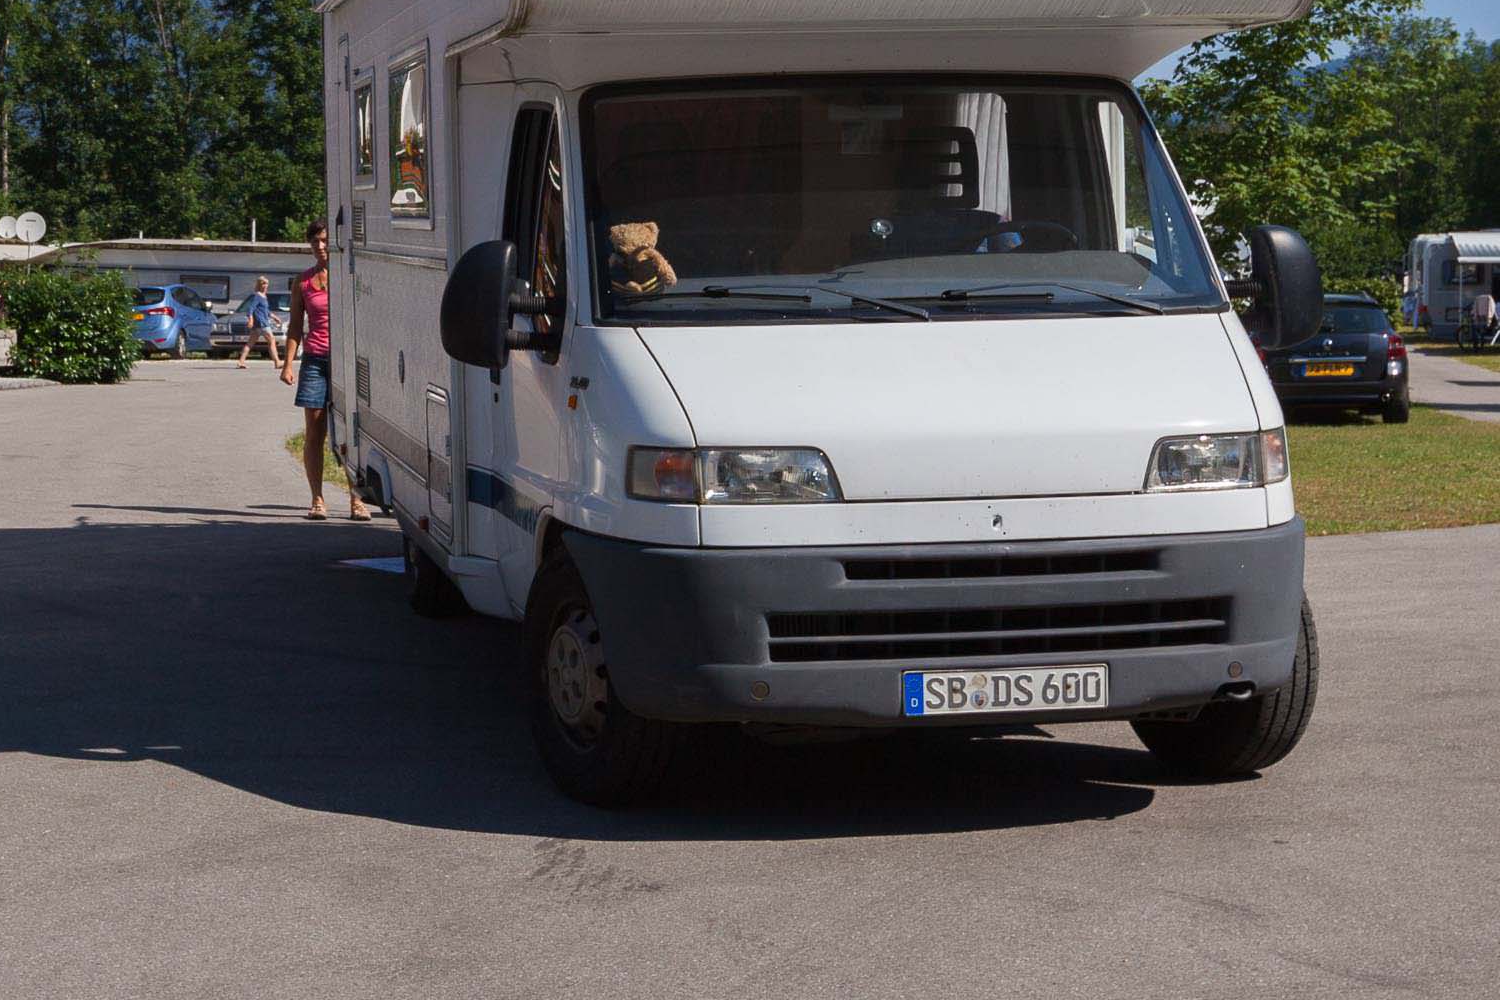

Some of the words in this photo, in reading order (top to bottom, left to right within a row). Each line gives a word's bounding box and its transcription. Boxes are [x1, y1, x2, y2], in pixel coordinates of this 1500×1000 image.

[910, 697, 919, 708] D
[925, 676, 968, 709] SB
[991, 674, 1033, 707] DS
[1041, 671, 1101, 704] 600
